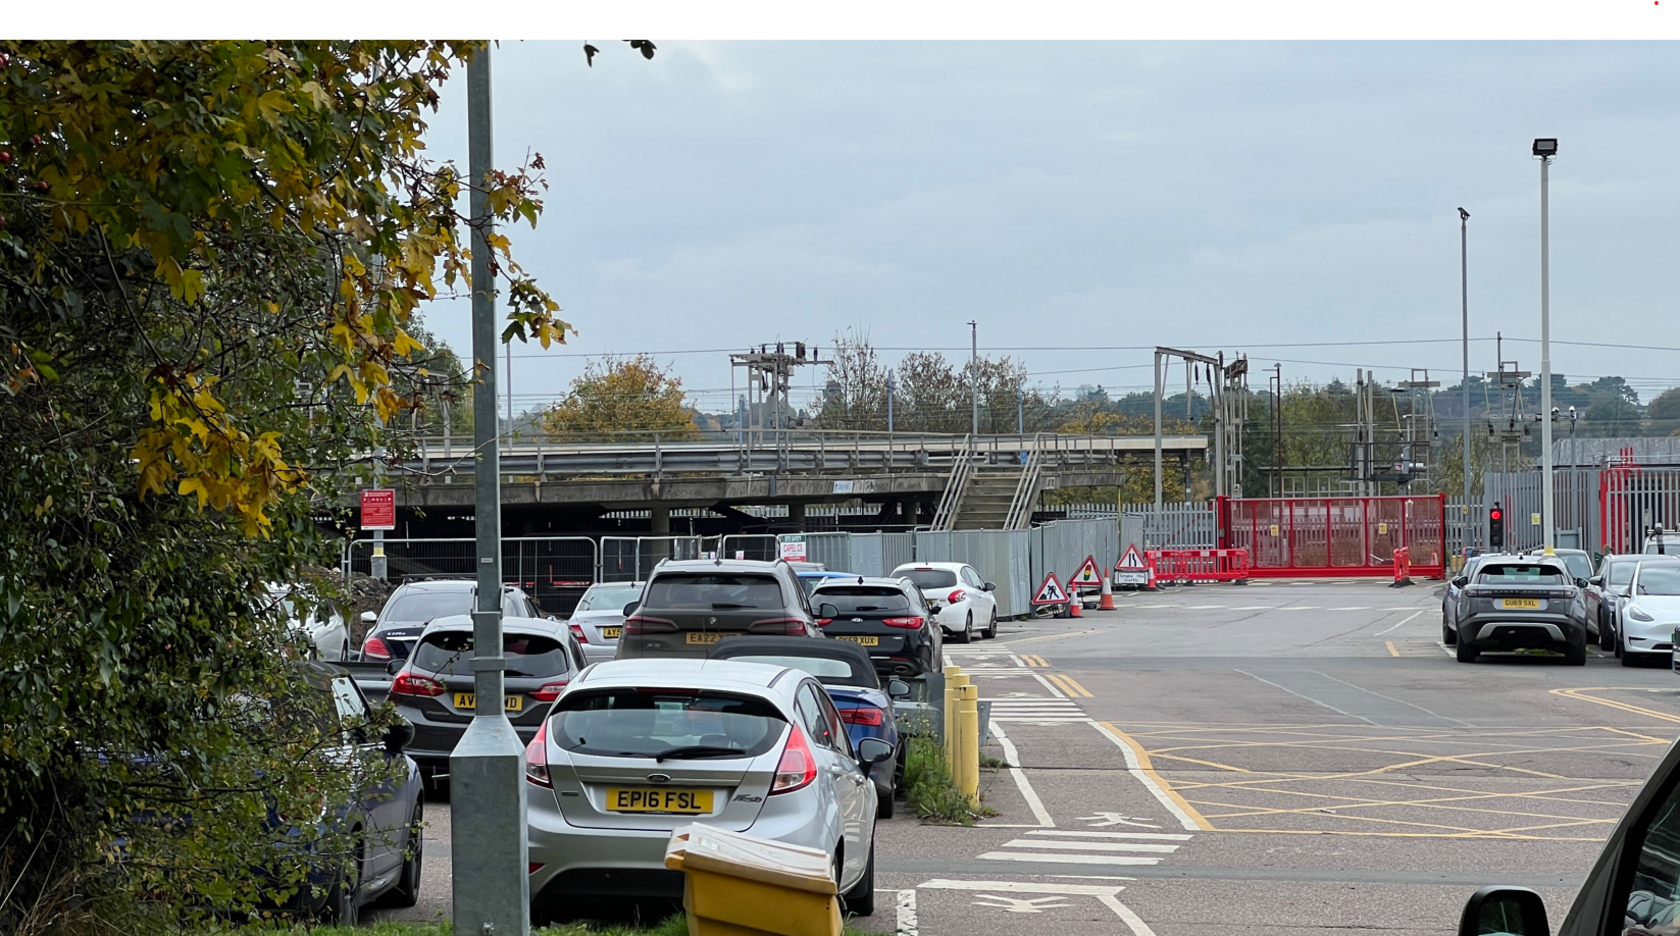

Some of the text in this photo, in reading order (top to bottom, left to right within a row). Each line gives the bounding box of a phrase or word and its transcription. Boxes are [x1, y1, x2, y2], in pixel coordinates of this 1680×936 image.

[690, 633, 716, 643] EA22
[617, 790, 702, 810] EP16 FSL
